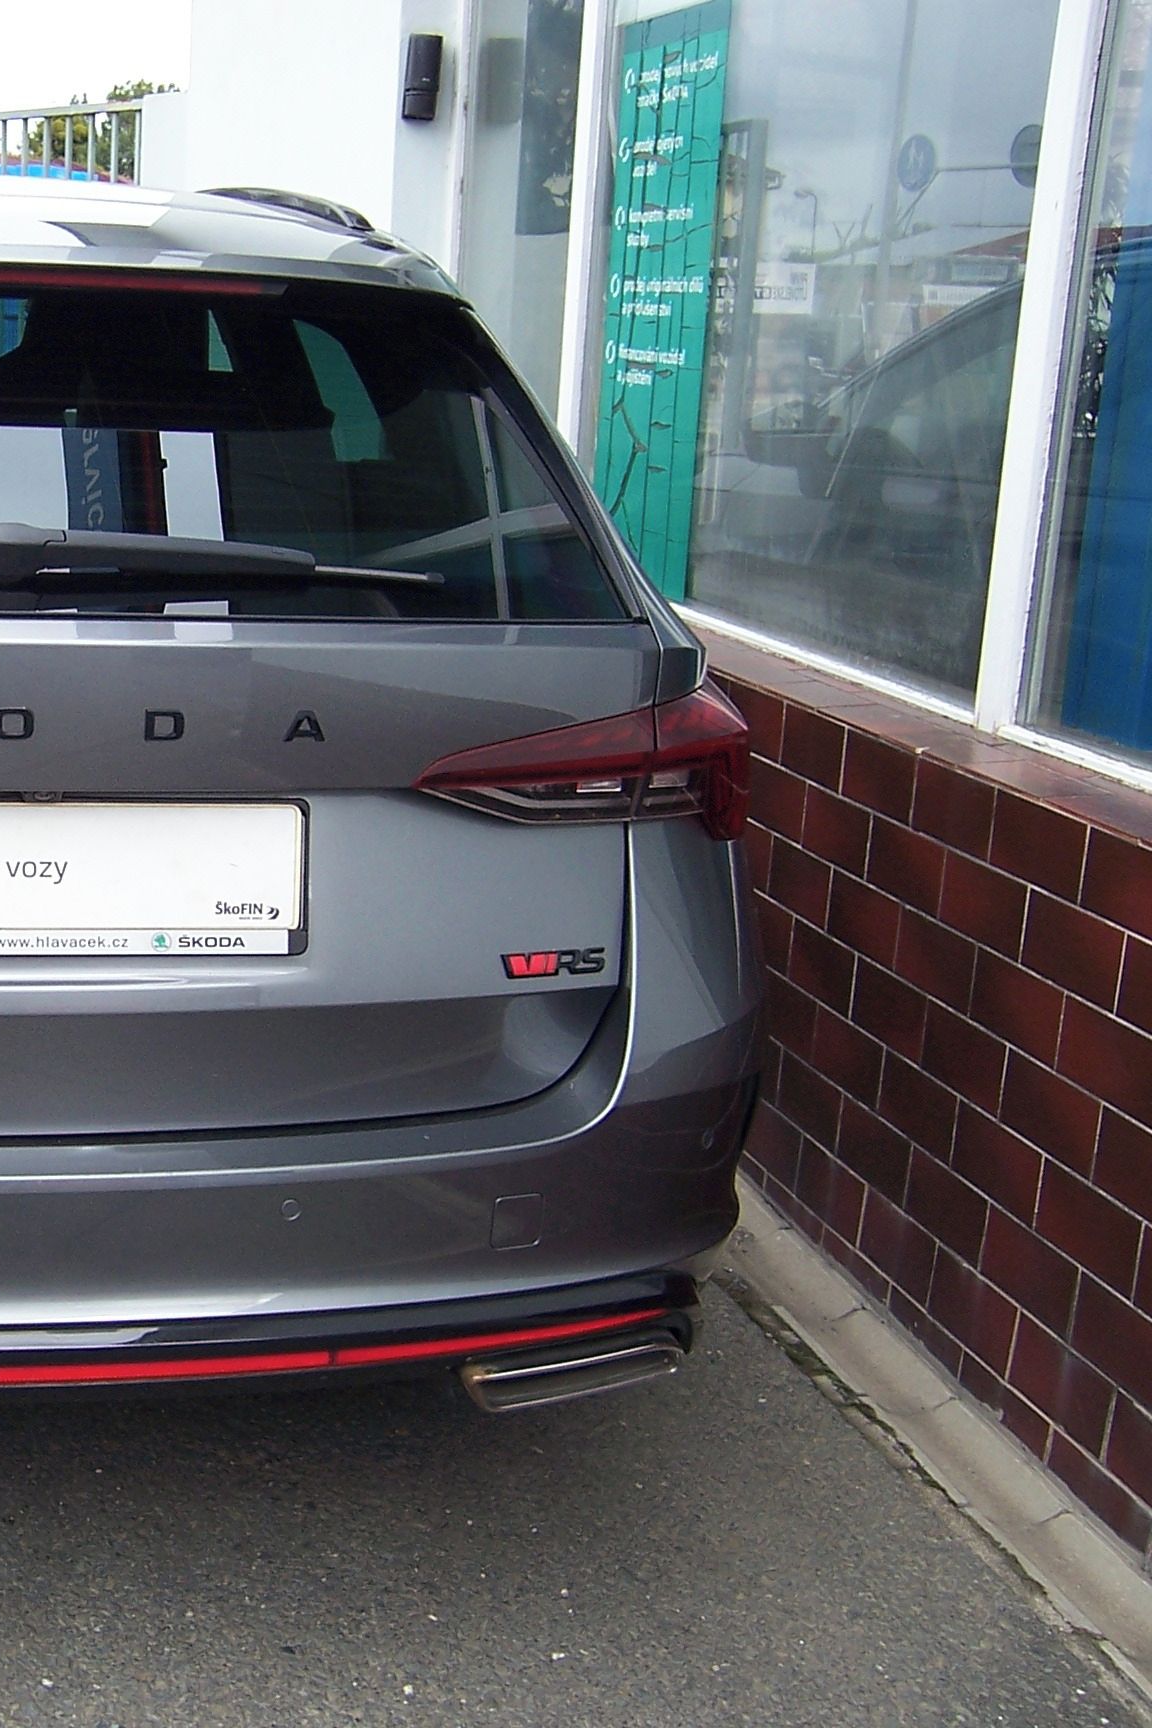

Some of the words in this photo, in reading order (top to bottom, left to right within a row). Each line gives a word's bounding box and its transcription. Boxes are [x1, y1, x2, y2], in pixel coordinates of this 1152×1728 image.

[6, 862, 67, 884] vozy
[216, 901, 262, 914] ŠkoFIN
[179, 937, 245, 947] ŠKODA
